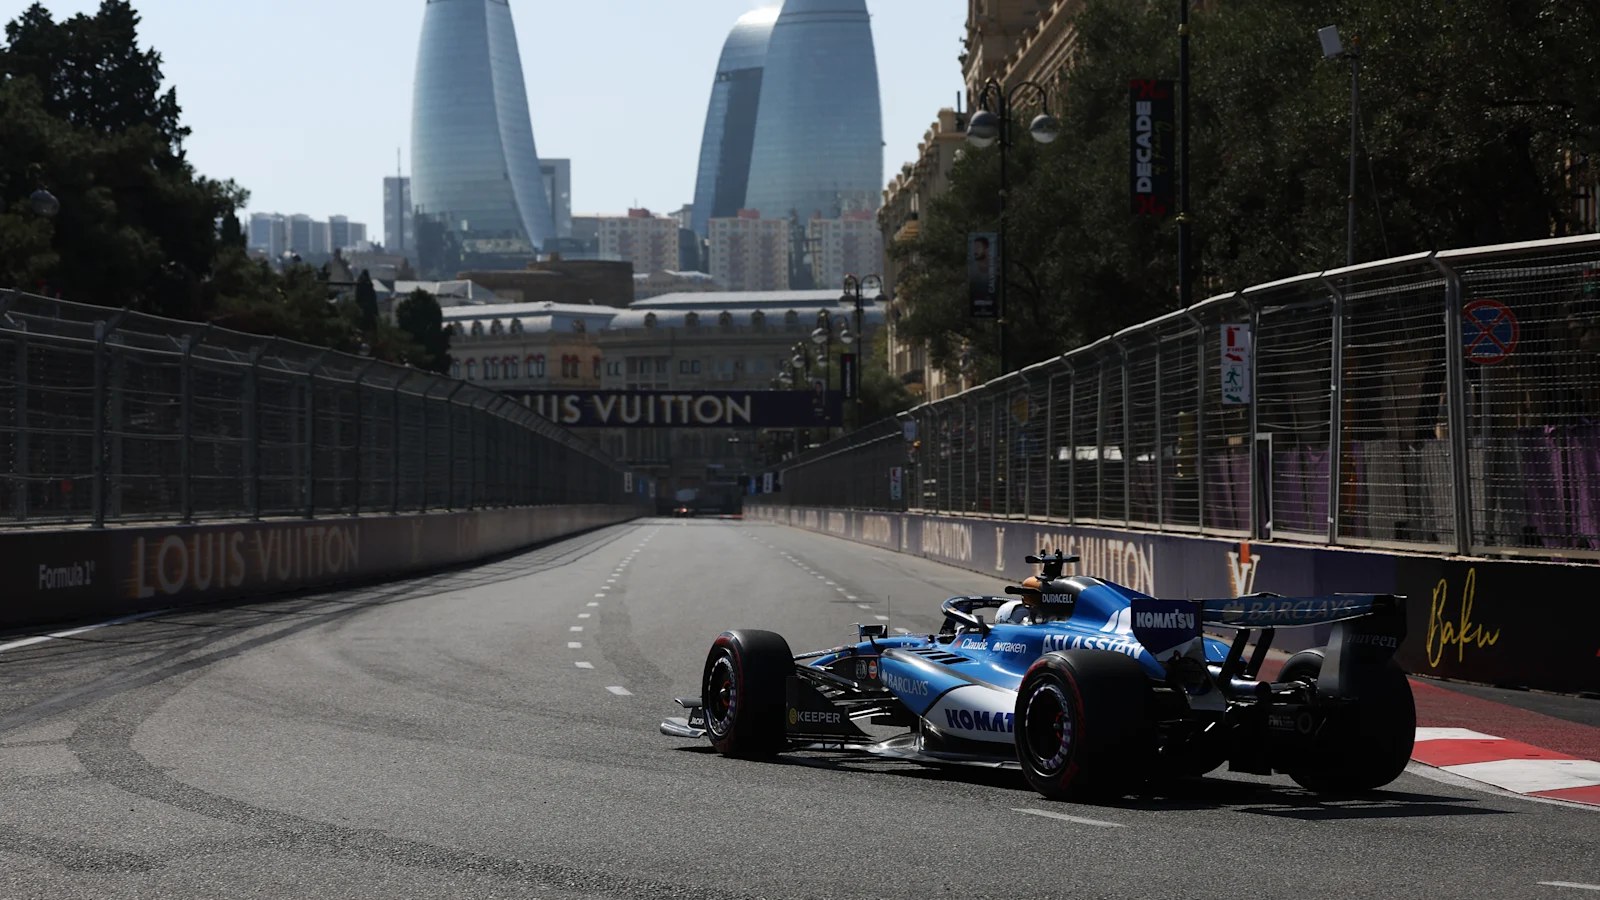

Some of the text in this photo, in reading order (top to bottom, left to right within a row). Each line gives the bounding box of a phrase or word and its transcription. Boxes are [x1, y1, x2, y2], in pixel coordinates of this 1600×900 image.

[1135, 100, 1152, 193] DECADE
[593, 394, 753, 425] VUITTON
[136, 530, 245, 599] LOUIS
[255, 524, 360, 583] VUITTON
[38, 562, 83, 591] Formula
[1042, 593, 1074, 604] DURACELL
[1248, 599, 1355, 621] BARCLAYS
[1136, 609, 1195, 629] KOMATSU
[1426, 567, 1500, 667] Baku
[961, 638, 988, 651] Claude
[888, 673, 929, 696] BARCLAYS
[797, 711, 841, 724] KEEPER
[944, 708, 1015, 733] KOMAT
